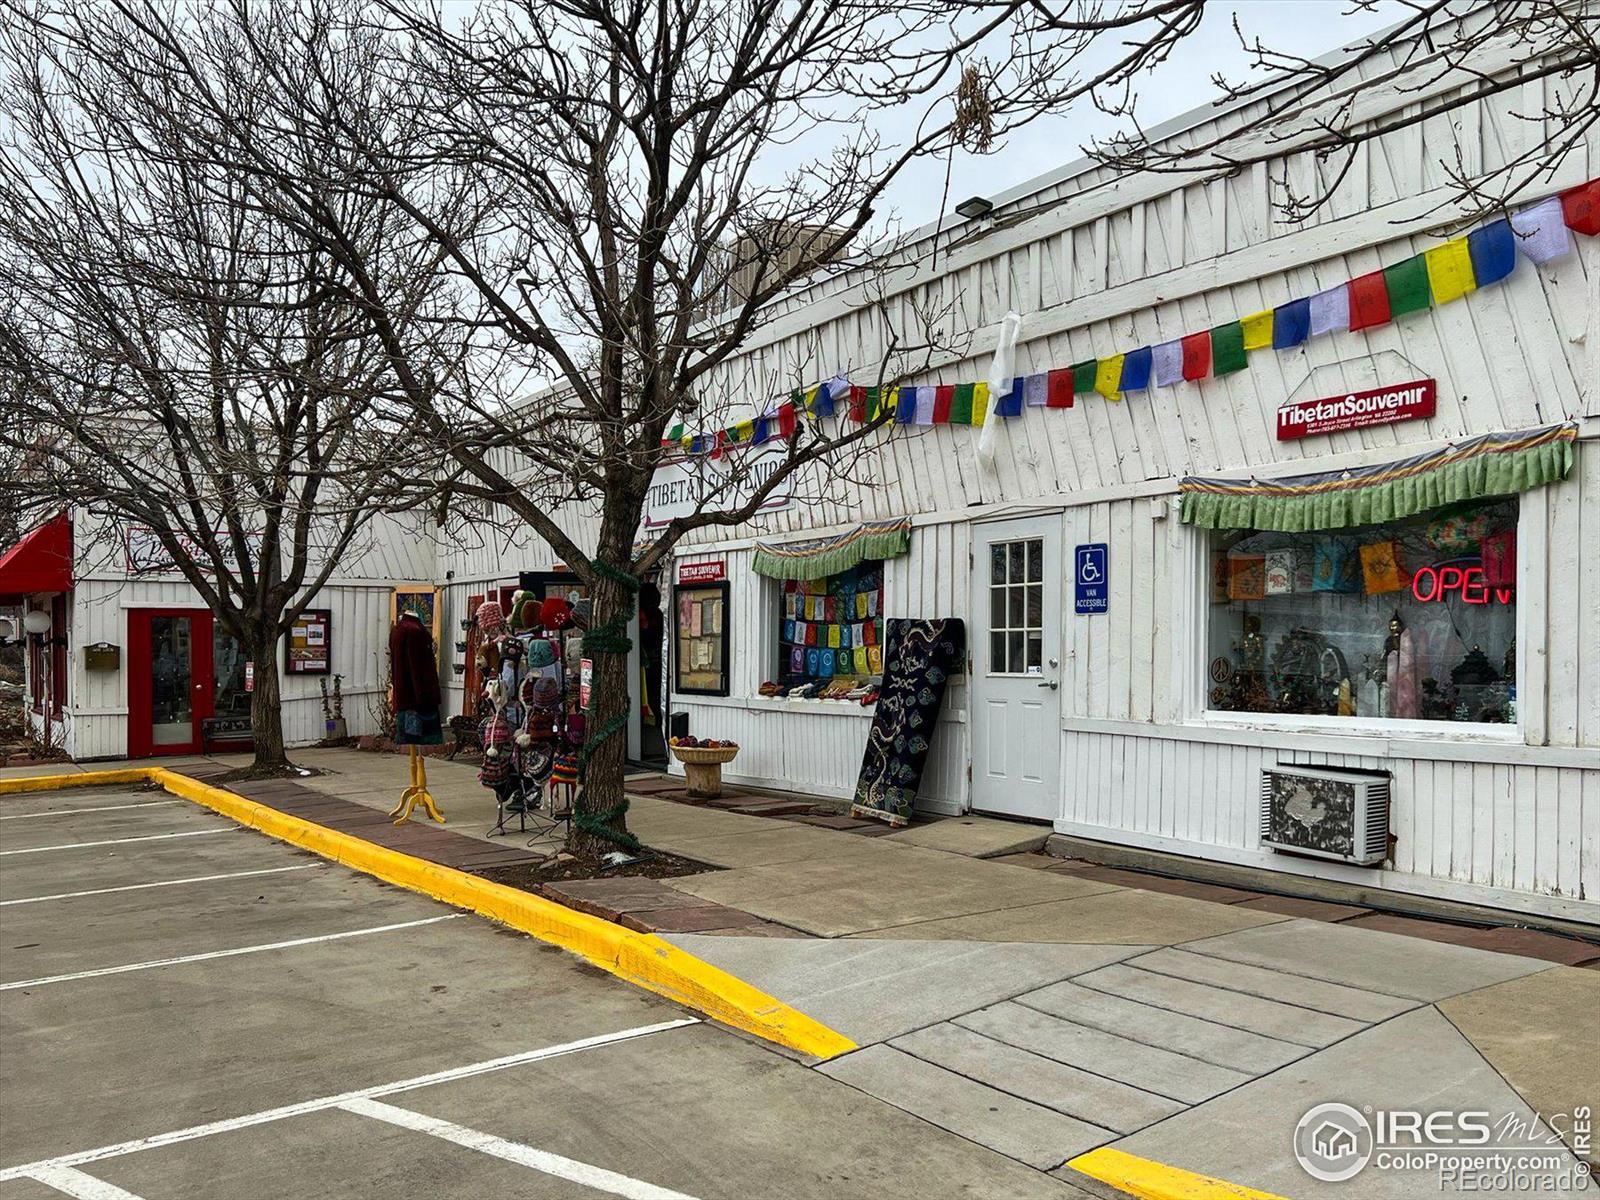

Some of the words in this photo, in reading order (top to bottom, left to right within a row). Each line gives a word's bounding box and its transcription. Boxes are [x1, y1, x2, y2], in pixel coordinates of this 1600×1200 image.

[1278, 386, 1427, 427] TibetanSouvenir
[708, 459, 788, 495] SOENIRS
[680, 567, 698, 577] TIBETAN
[1077, 599, 1107, 607] ACCESSIBLE
